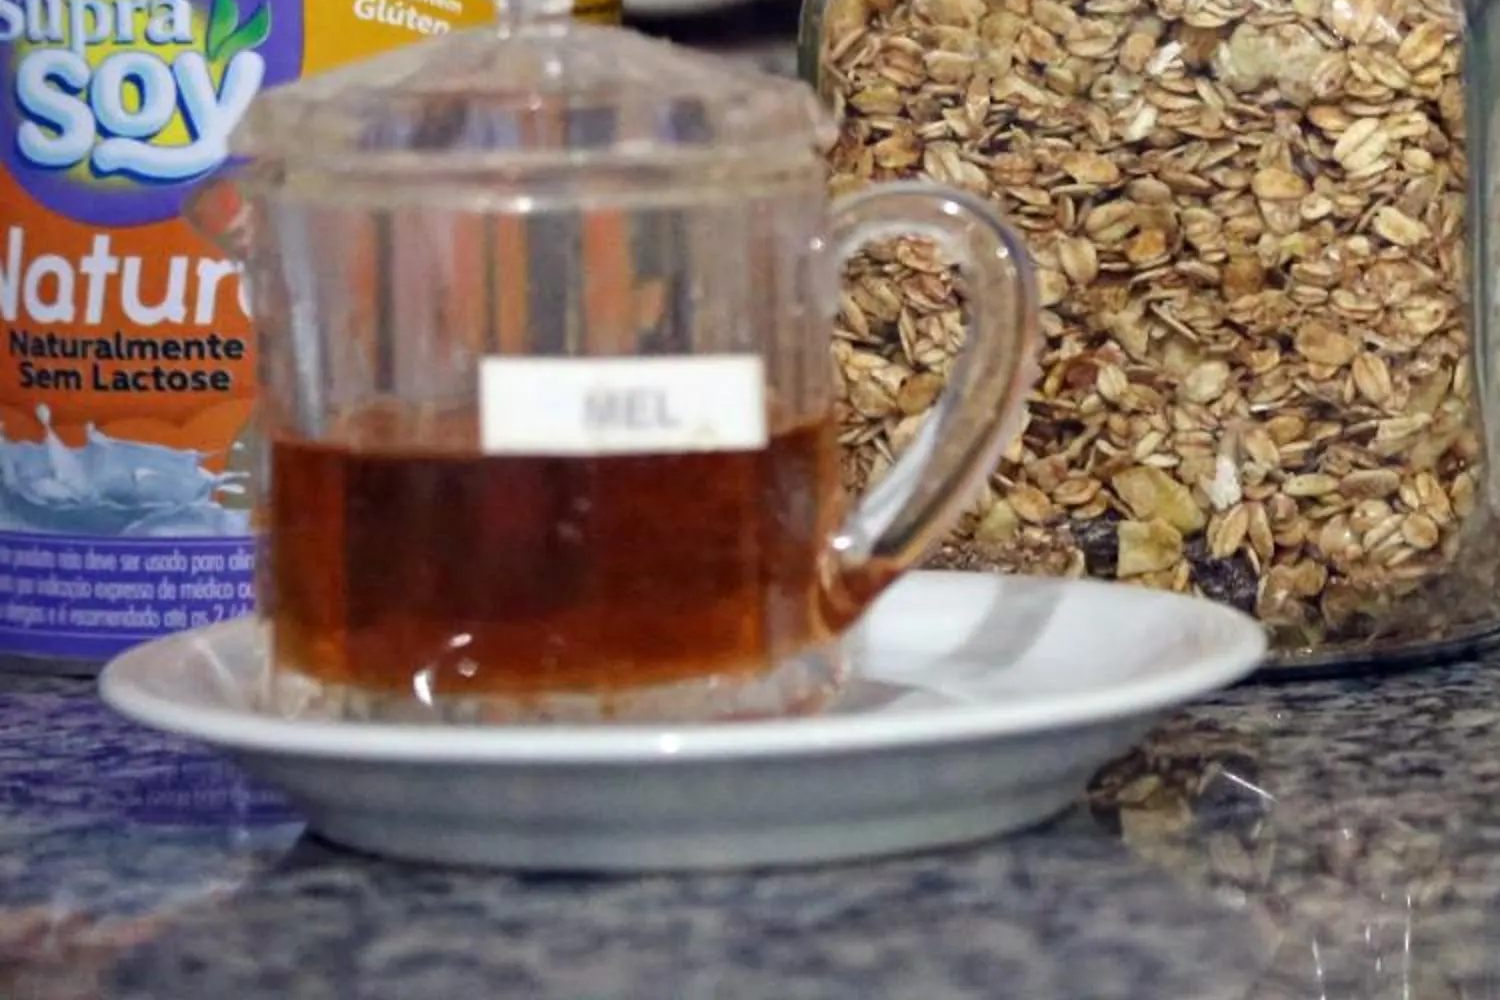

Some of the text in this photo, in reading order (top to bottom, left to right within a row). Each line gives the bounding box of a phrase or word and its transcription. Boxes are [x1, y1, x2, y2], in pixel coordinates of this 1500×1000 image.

[9, 328, 246, 362] Naturalmente
[19, 361, 231, 393] Sem Lactose
[144, 548, 188, 572] usado
[191, 554, 225, 576] para
[157, 575, 177, 600] de
[180, 576, 234, 600] médico
